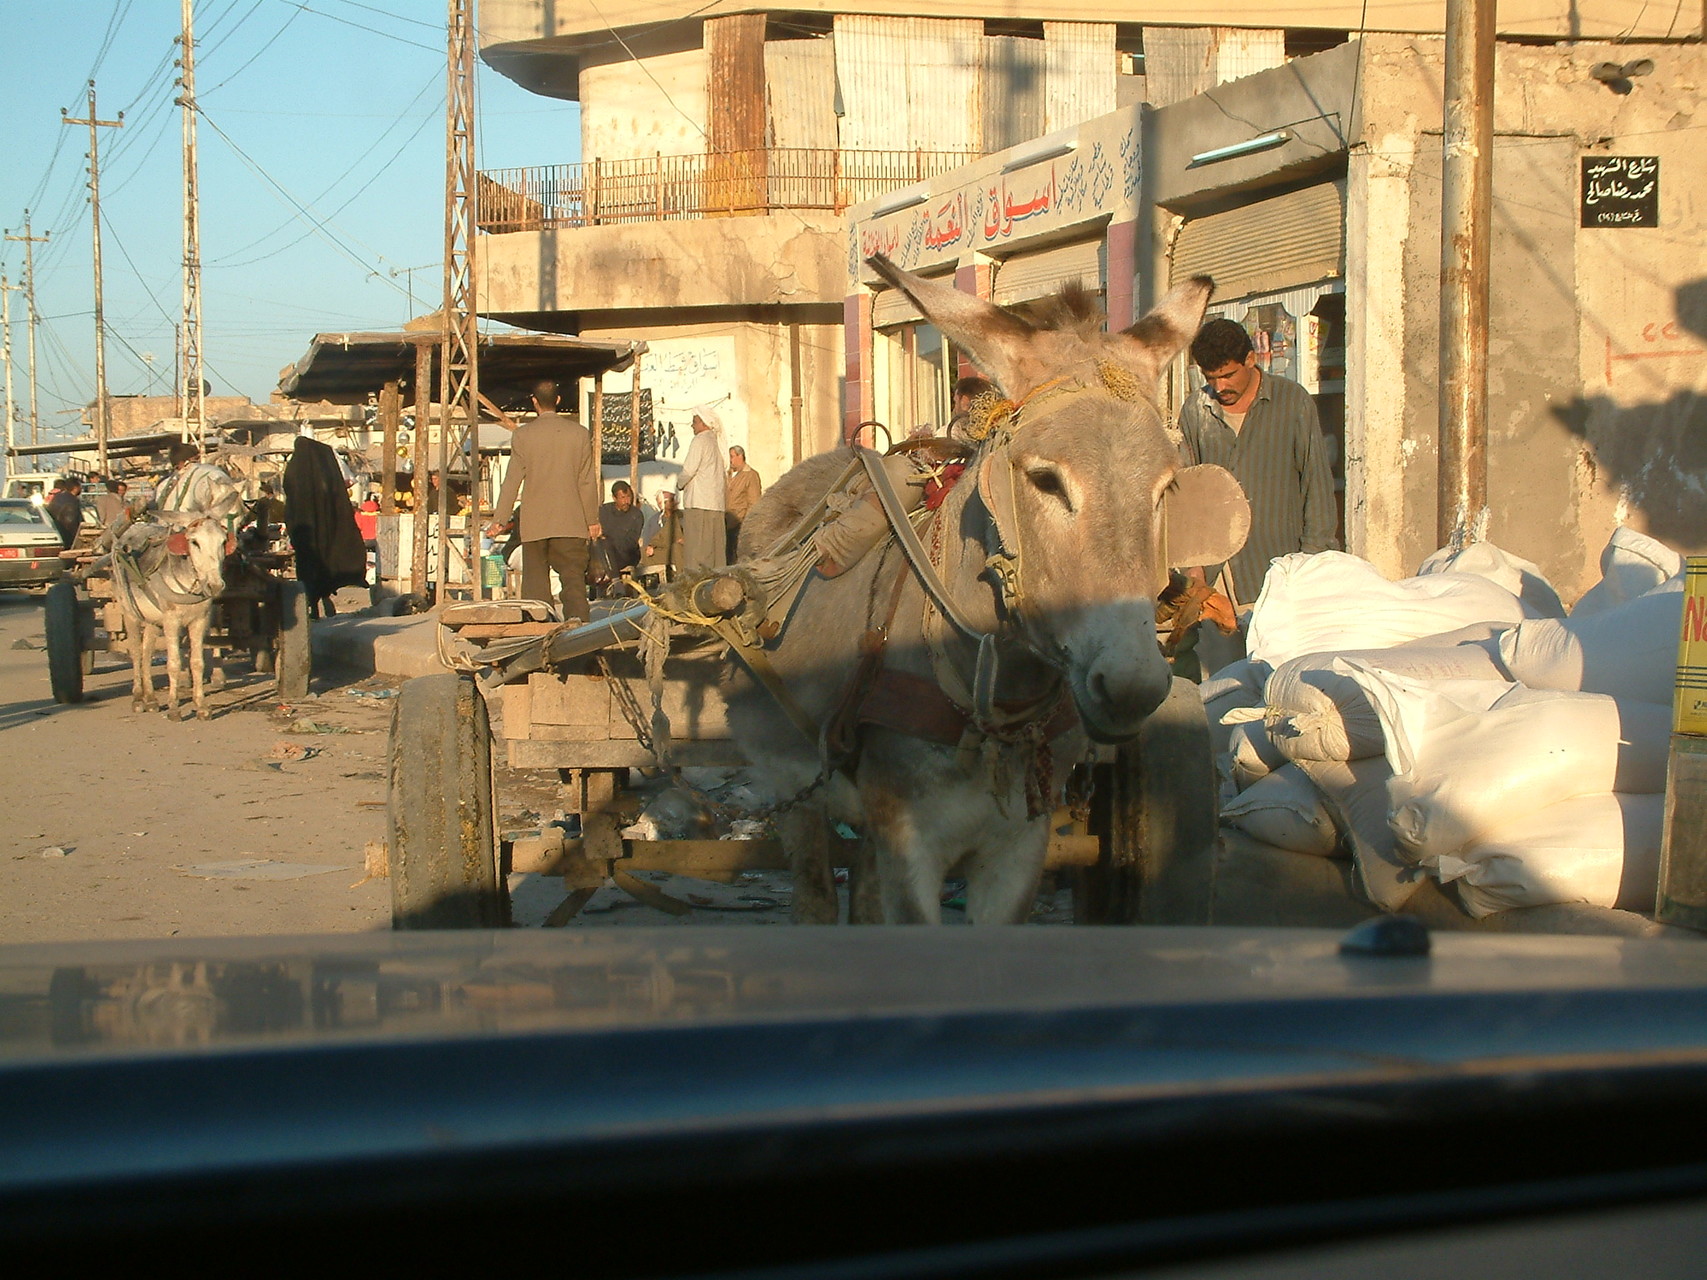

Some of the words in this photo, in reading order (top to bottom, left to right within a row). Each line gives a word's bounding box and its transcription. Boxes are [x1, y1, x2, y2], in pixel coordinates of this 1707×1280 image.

[1587, 157, 1627, 179] الشهيد
[1627, 158, 1657, 179] شارع
[1586, 180, 1611, 205] صالح
[1611, 179, 1631, 199] رضا
[1630, 180, 1655, 200] محمد
